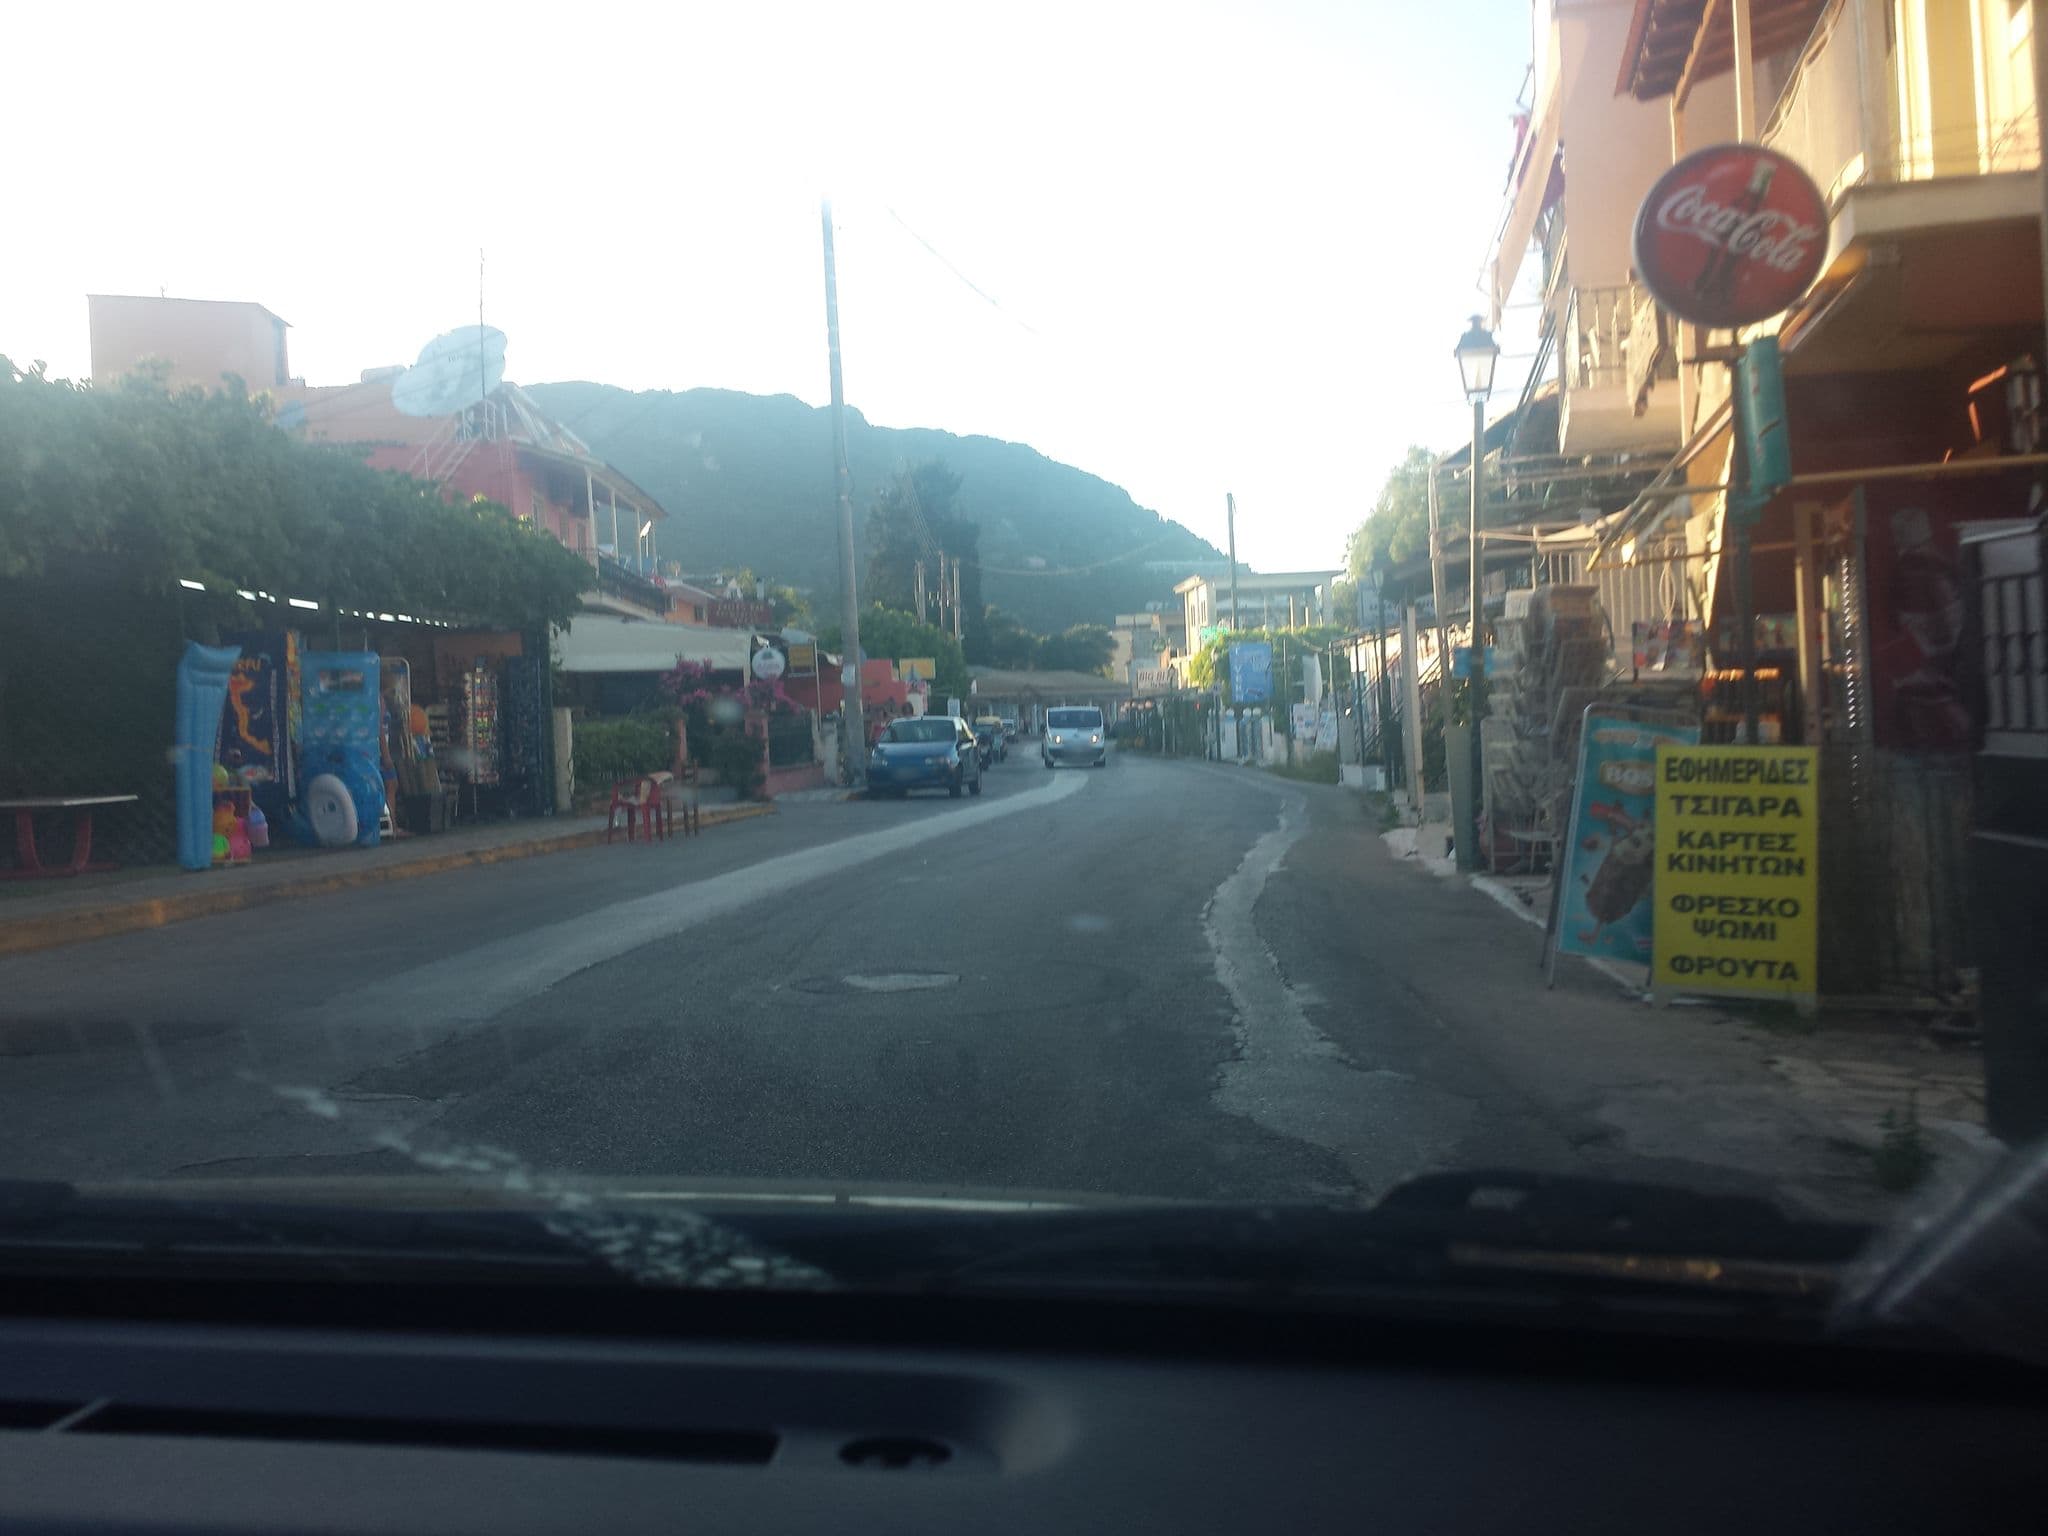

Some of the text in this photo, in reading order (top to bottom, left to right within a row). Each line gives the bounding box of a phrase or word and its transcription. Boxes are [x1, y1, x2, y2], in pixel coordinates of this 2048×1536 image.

[1657, 185, 1819, 272] Coca-Cola
[1667, 758, 1809, 785] ΕΦΗΜΕΡΙΔΕΣ
[1669, 796, 1801, 818] ΤΣΙΓΑΡΑ
[1678, 831, 1796, 852] ΚΑΡΤΕΣ
[1667, 854, 1805, 876] ΚΙΝΗΤΩΝ
[1671, 895, 1800, 919] ΦΡΕΣΚΟ
[1694, 919, 1777, 941] ΨΩΜΙ
[1670, 956, 1799, 981] ΦΡΟΥΤΑ
